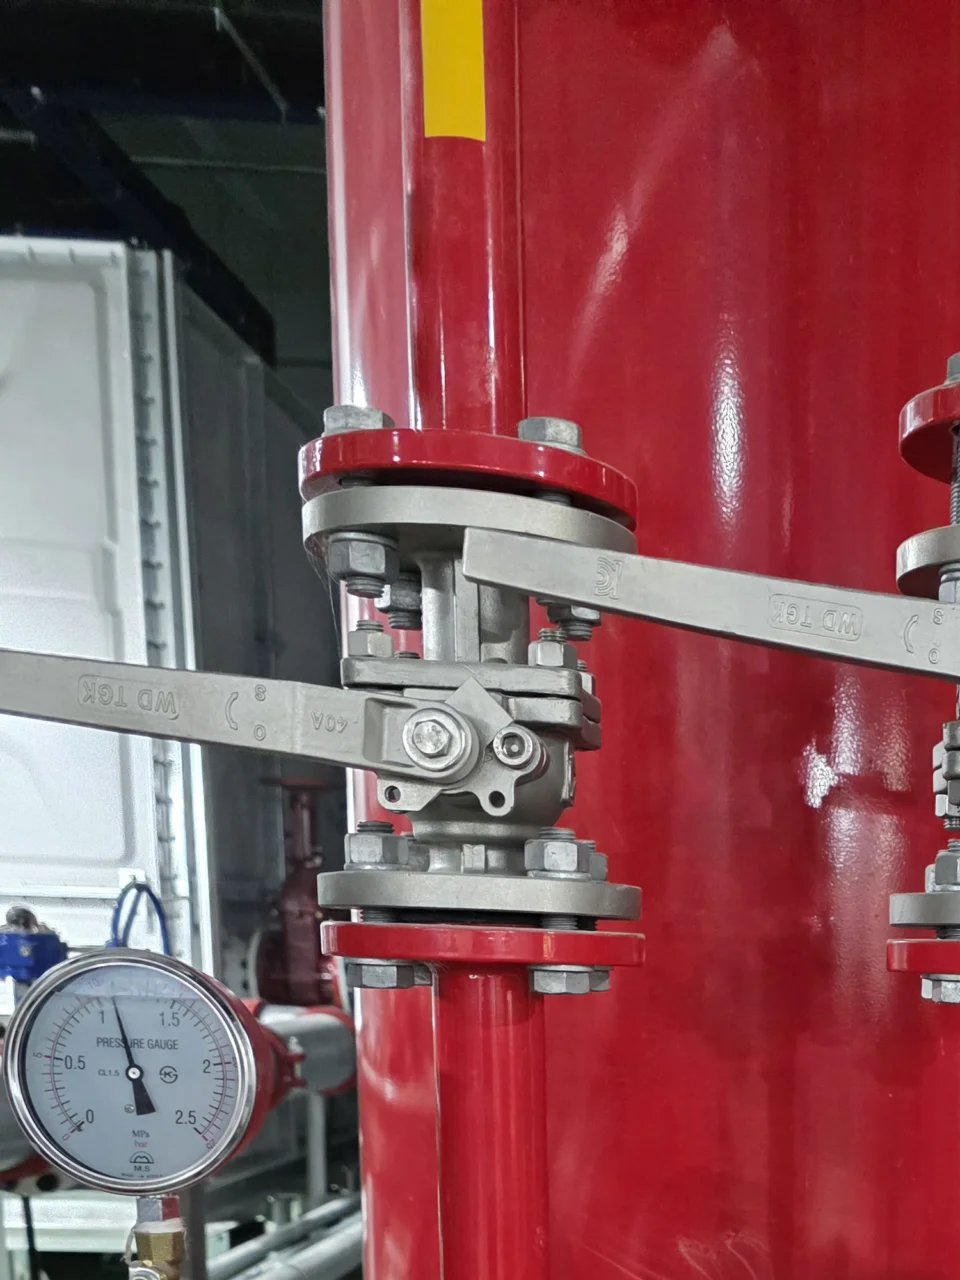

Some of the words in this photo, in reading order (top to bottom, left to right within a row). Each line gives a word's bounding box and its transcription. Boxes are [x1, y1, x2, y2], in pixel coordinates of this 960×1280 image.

[771, 600, 812, 628] TGK
[932, 608, 944, 625] S
[822, 610, 861, 637] WD
[82, 682, 128, 708] TGK
[254, 684, 267, 702] S
[139, 689, 178, 717] WD
[310, 711, 349, 733] 40A
[99, 1011, 105, 1024] 1
[159, 1012, 180, 1026] 1.5
[147, 1038, 179, 1050] GAUGE
[64, 1055, 86, 1071] 0.5
[202, 1060, 211, 1074] 2
[86, 1109, 94, 1124] 0
[175, 1110, 196, 1126] 2.5
[132, 1130, 150, 1138] MPa
